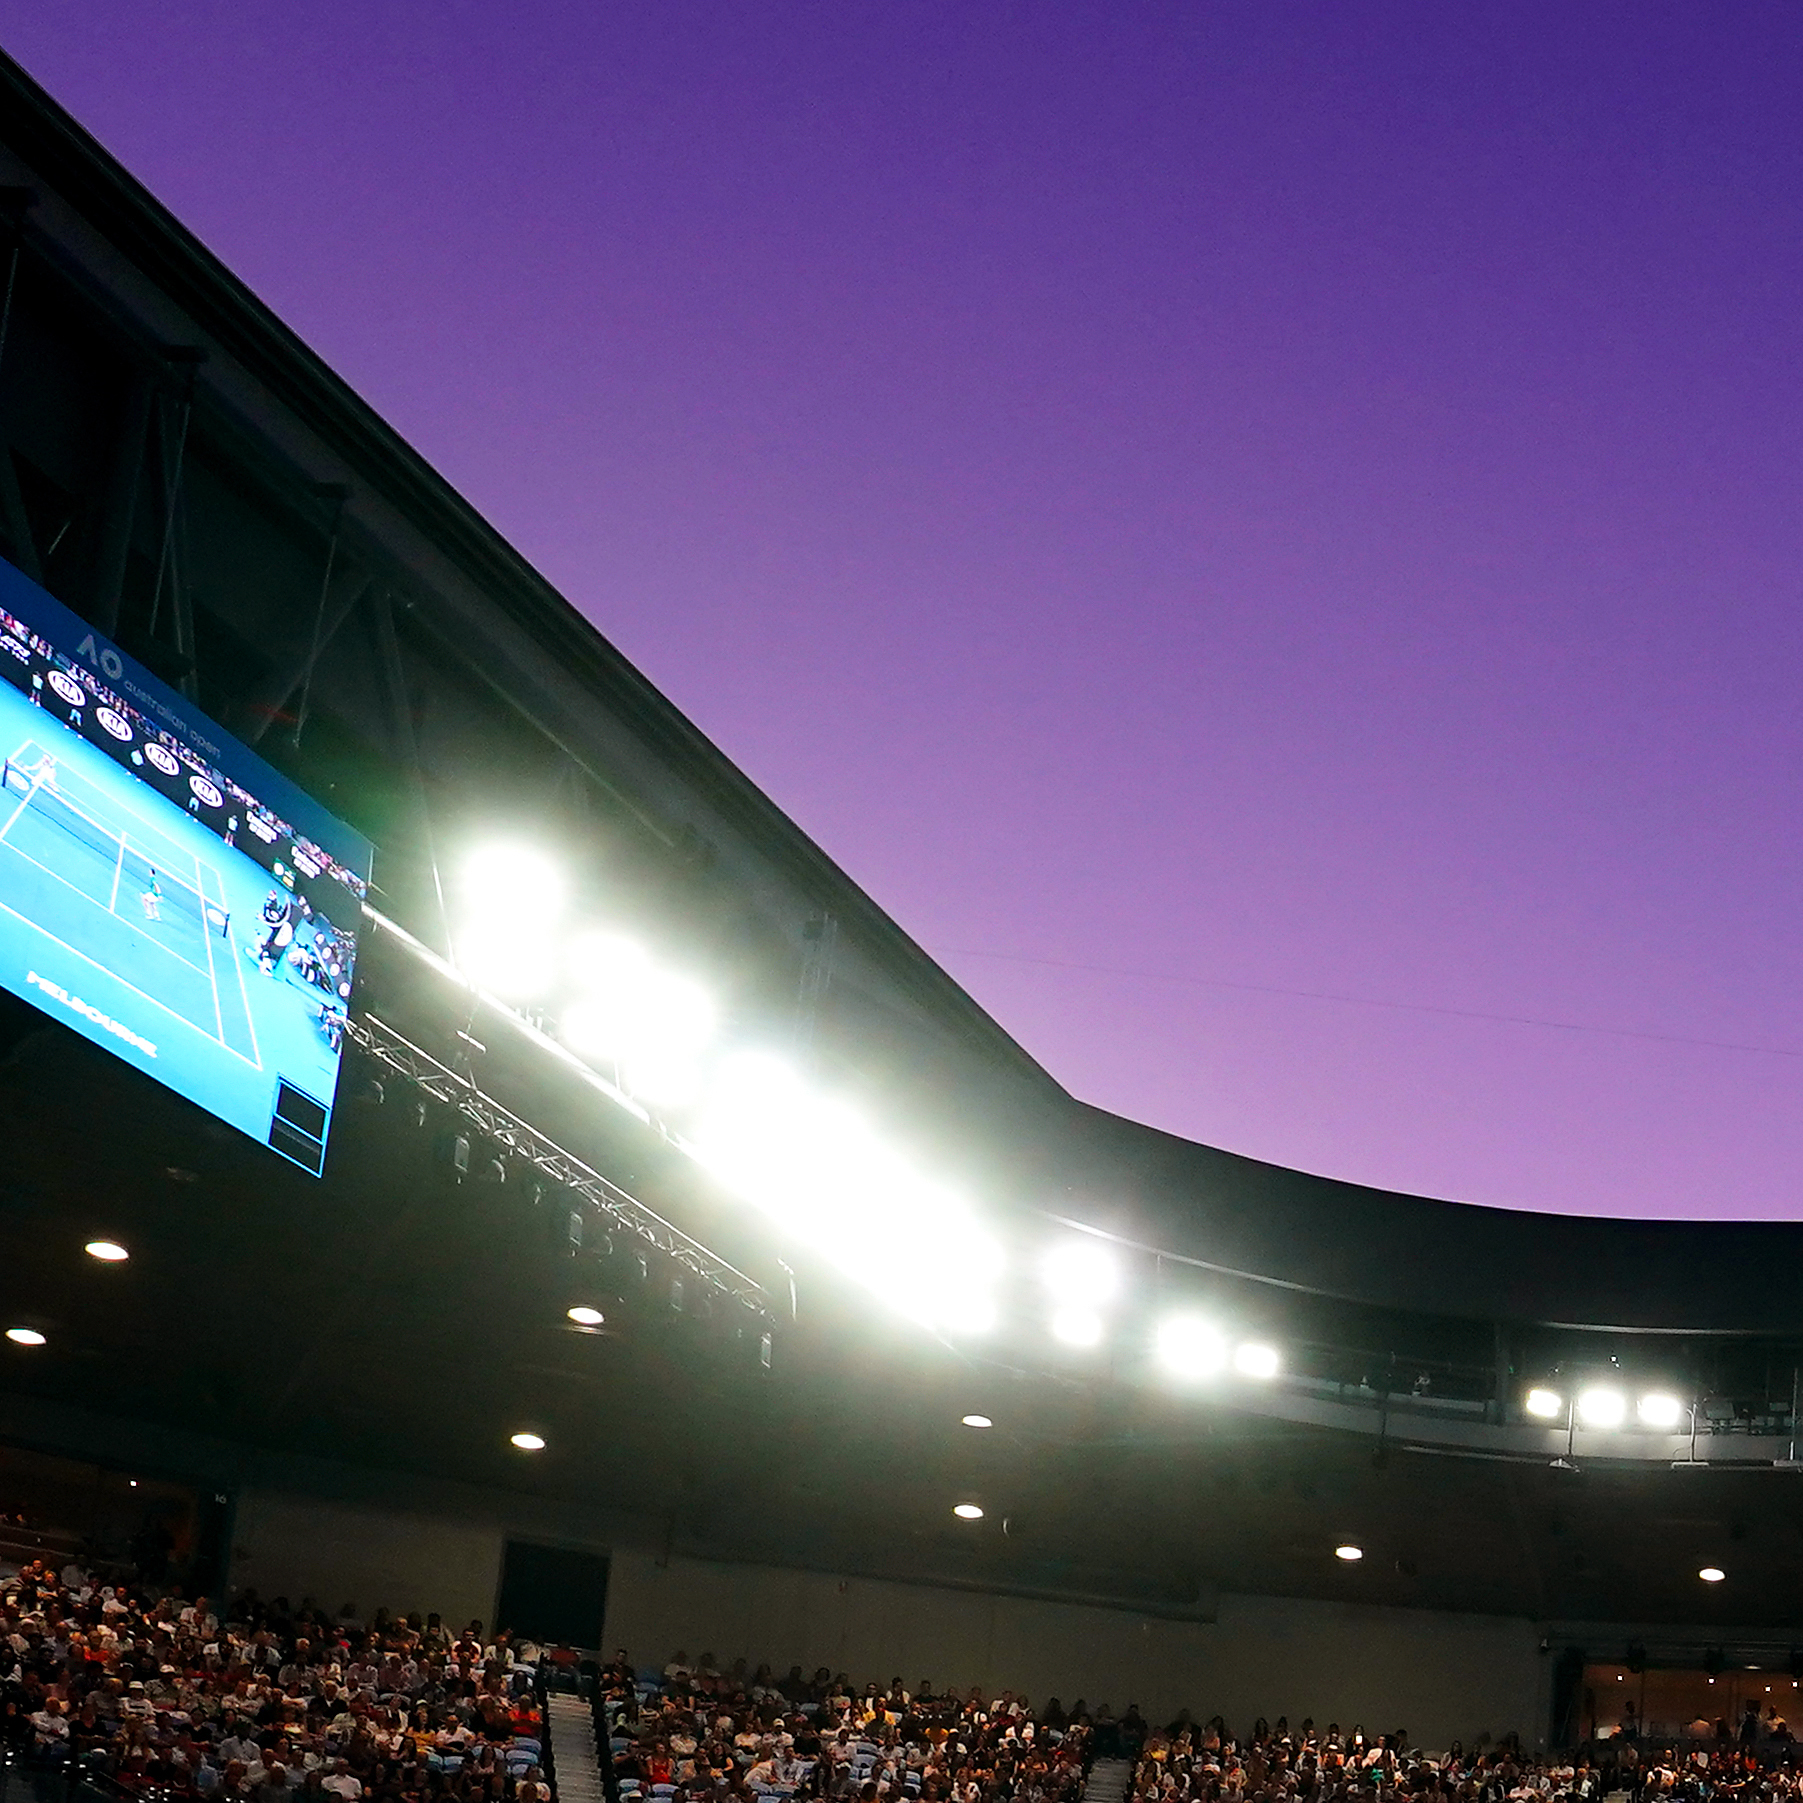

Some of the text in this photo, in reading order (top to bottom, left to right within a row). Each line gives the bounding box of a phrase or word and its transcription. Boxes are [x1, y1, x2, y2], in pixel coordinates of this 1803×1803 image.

[77, 634, 123, 680] AO
[124, 679, 221, 758] australian open
